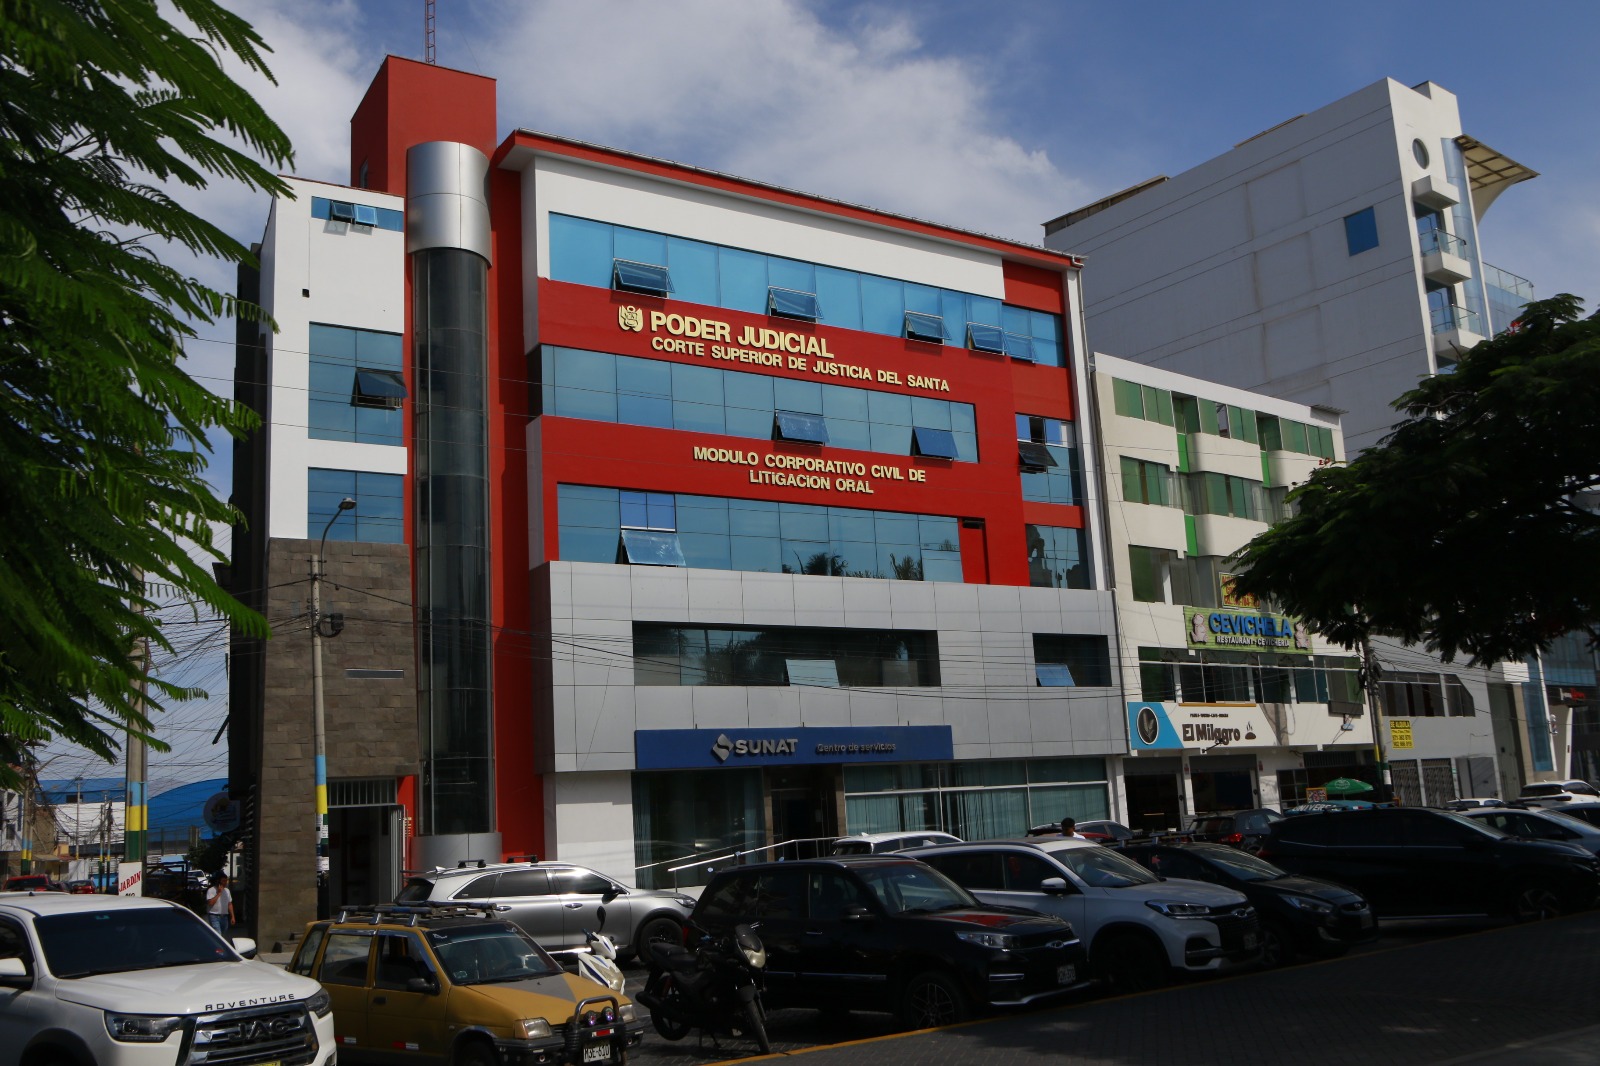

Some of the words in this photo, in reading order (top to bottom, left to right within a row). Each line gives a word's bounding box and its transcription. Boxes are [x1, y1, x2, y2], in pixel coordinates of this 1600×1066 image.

[650, 310, 731, 343] PODER
[737, 325, 835, 359] JUDICIAL
[651, 336, 705, 357] CORTE
[711, 345, 782, 368] SUPERIOR
[788, 356, 807, 371] DE
[812, 360, 872, 381] JUSTICIA
[877, 369, 902, 386] DEL
[907, 374, 950, 392] SANTA
[693, 446, 759, 466] MODULO
[764, 453, 866, 477] CORPORATIVO
[870, 464, 905, 481] CIVIL
[908, 468, 926, 483] DE
[749, 469, 831, 490] LITIGACION
[835, 477, 874, 494] ORAL
[1208, 612, 1293, 639] CEVICHELA
[1216, 635, 1254, 646] RESTAURANT
[1257, 638, 1290, 648] CEVICHERIA
[735, 738, 798, 754] SUNAT
[1182, 724, 1195, 742] El
[1195, 724, 1241, 746] Milagro
[817, 743, 846, 752] Centro
[848, 742, 859, 751] de
[860, 742, 897, 751] servicios
[118, 870, 142, 893] JARDIN
[205, 993, 295, 1011] ADVENTURE
